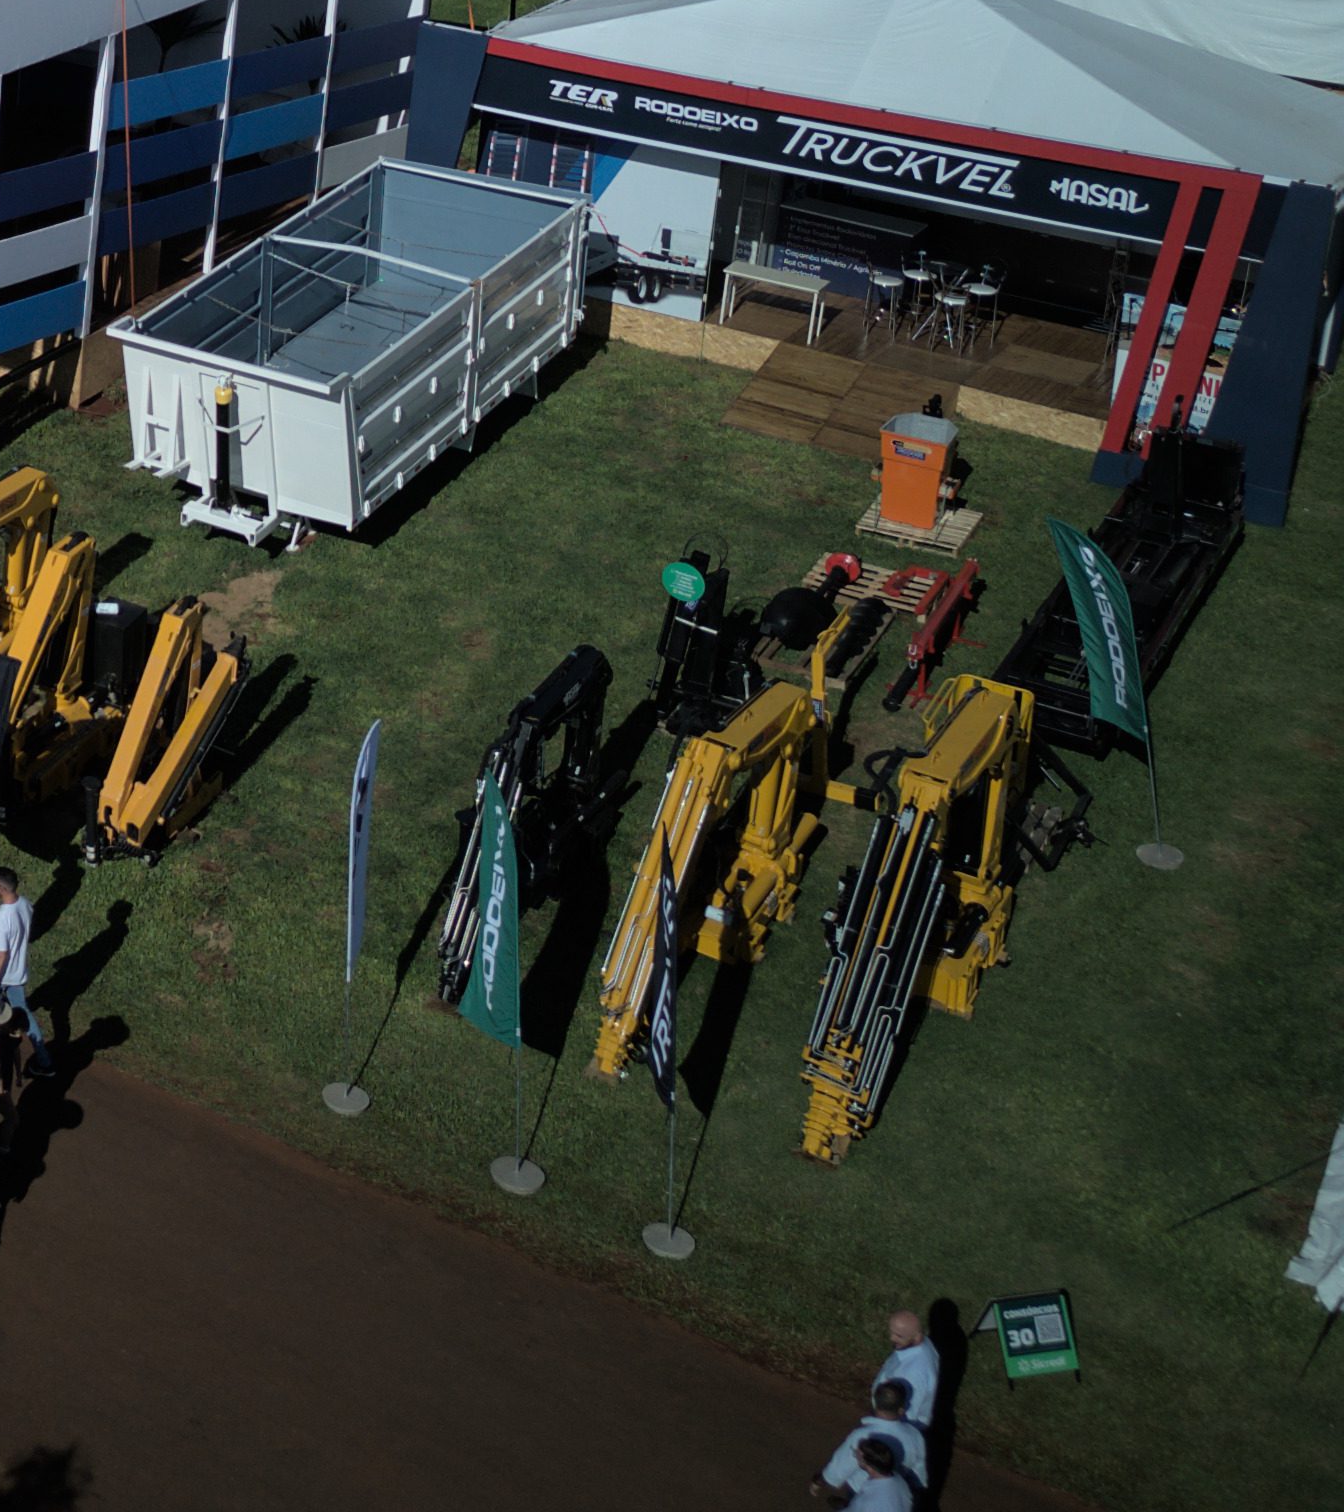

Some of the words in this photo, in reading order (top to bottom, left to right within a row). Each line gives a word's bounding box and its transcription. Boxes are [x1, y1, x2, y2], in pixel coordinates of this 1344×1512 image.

[548, 79, 619, 107] TER
[634, 96, 759, 132] RODOEIXO
[776, 114, 1021, 201] TRUCKVEL
[1049, 176, 1149, 216] MASAL
[784, 248, 820, 263] Caçamba
[820, 256, 848, 269] Minério
[797, 261, 808, 269] On
[1078, 545, 1129, 710] RODOEIXO
[1007, 1327, 1035, 1348] 30
